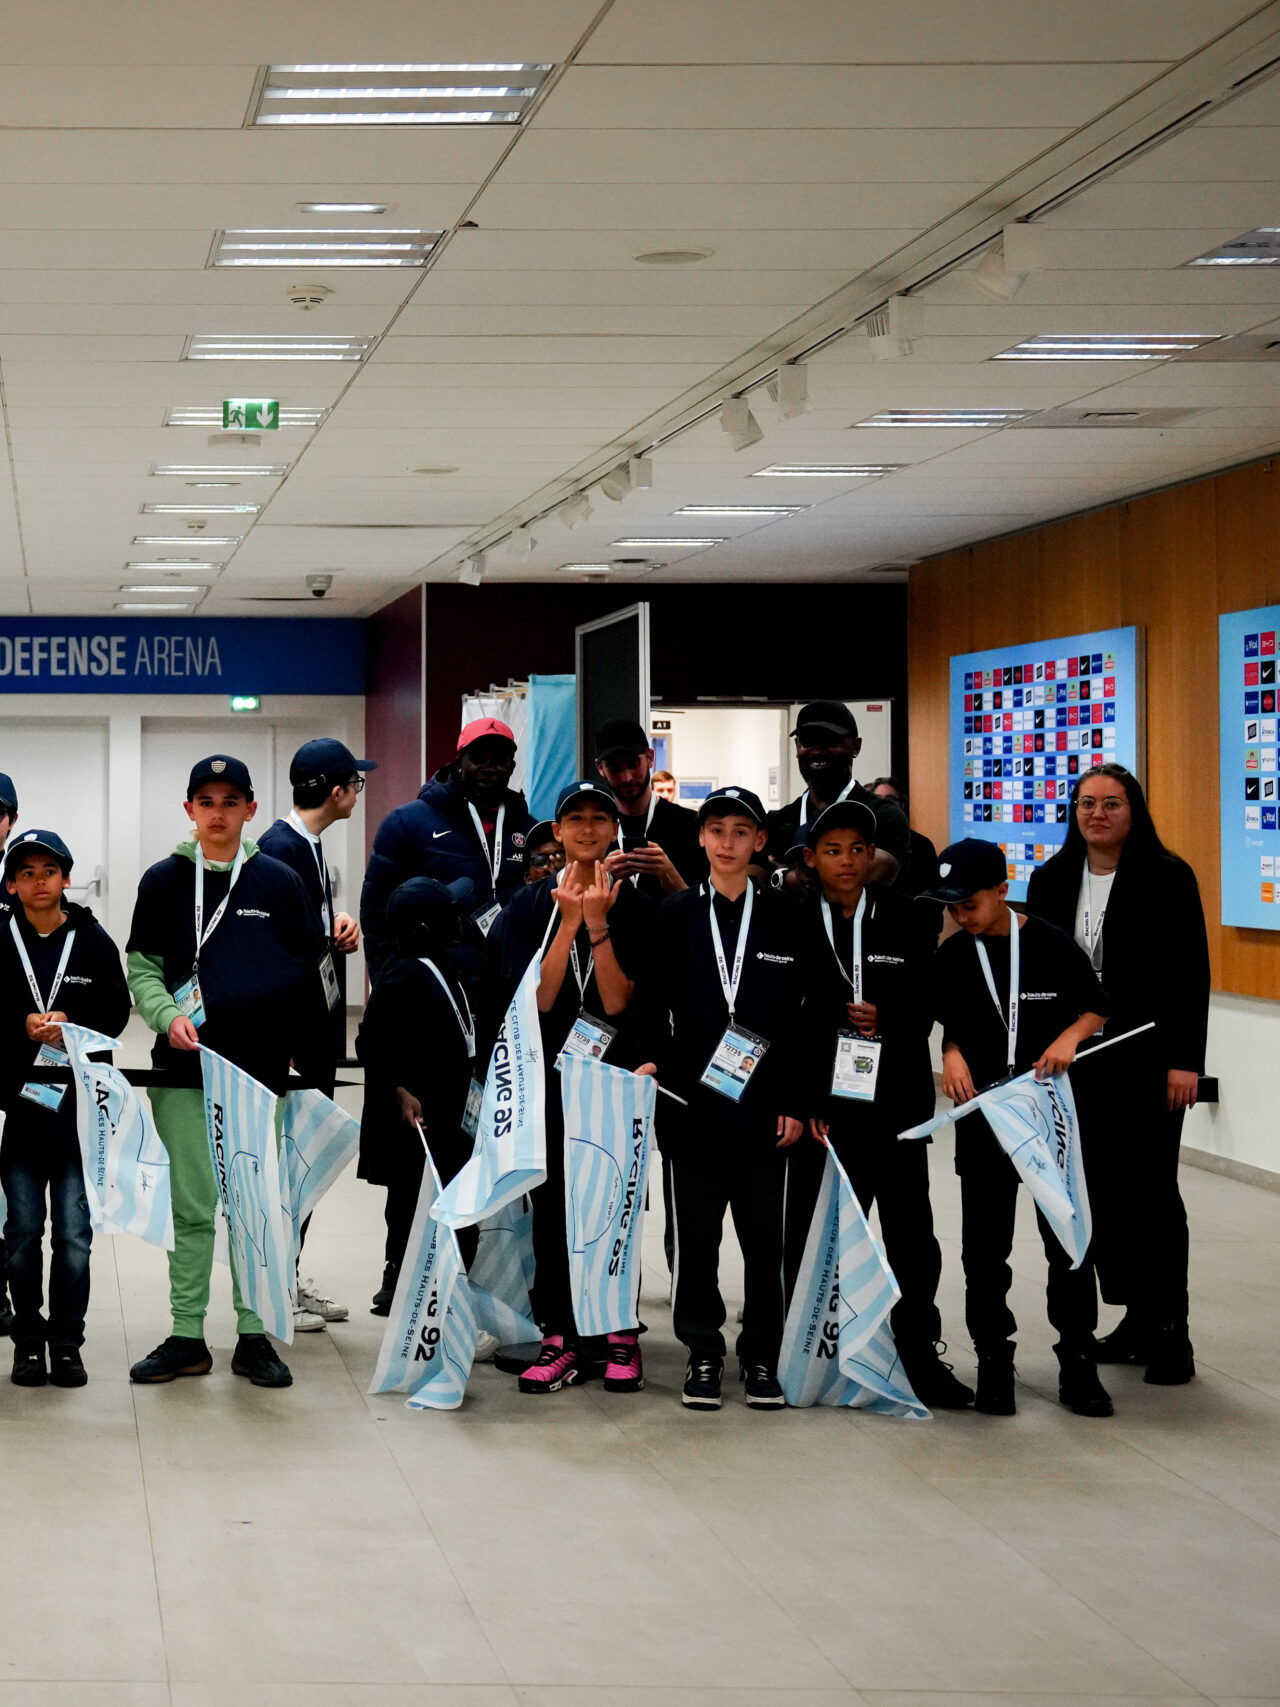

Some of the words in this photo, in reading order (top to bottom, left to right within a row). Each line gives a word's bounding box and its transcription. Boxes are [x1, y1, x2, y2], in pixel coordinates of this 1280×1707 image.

[134, 635, 221, 677] ARENA
[214, 1103, 229, 1205] RACING
[424, 1253, 434, 1272] DES
[825, 1246, 834, 1266] DES
[401, 1275, 430, 1358] HAUTS-DE-SEINE
[414, 1324, 440, 1361] 92
[816, 1320, 839, 1360] 92
